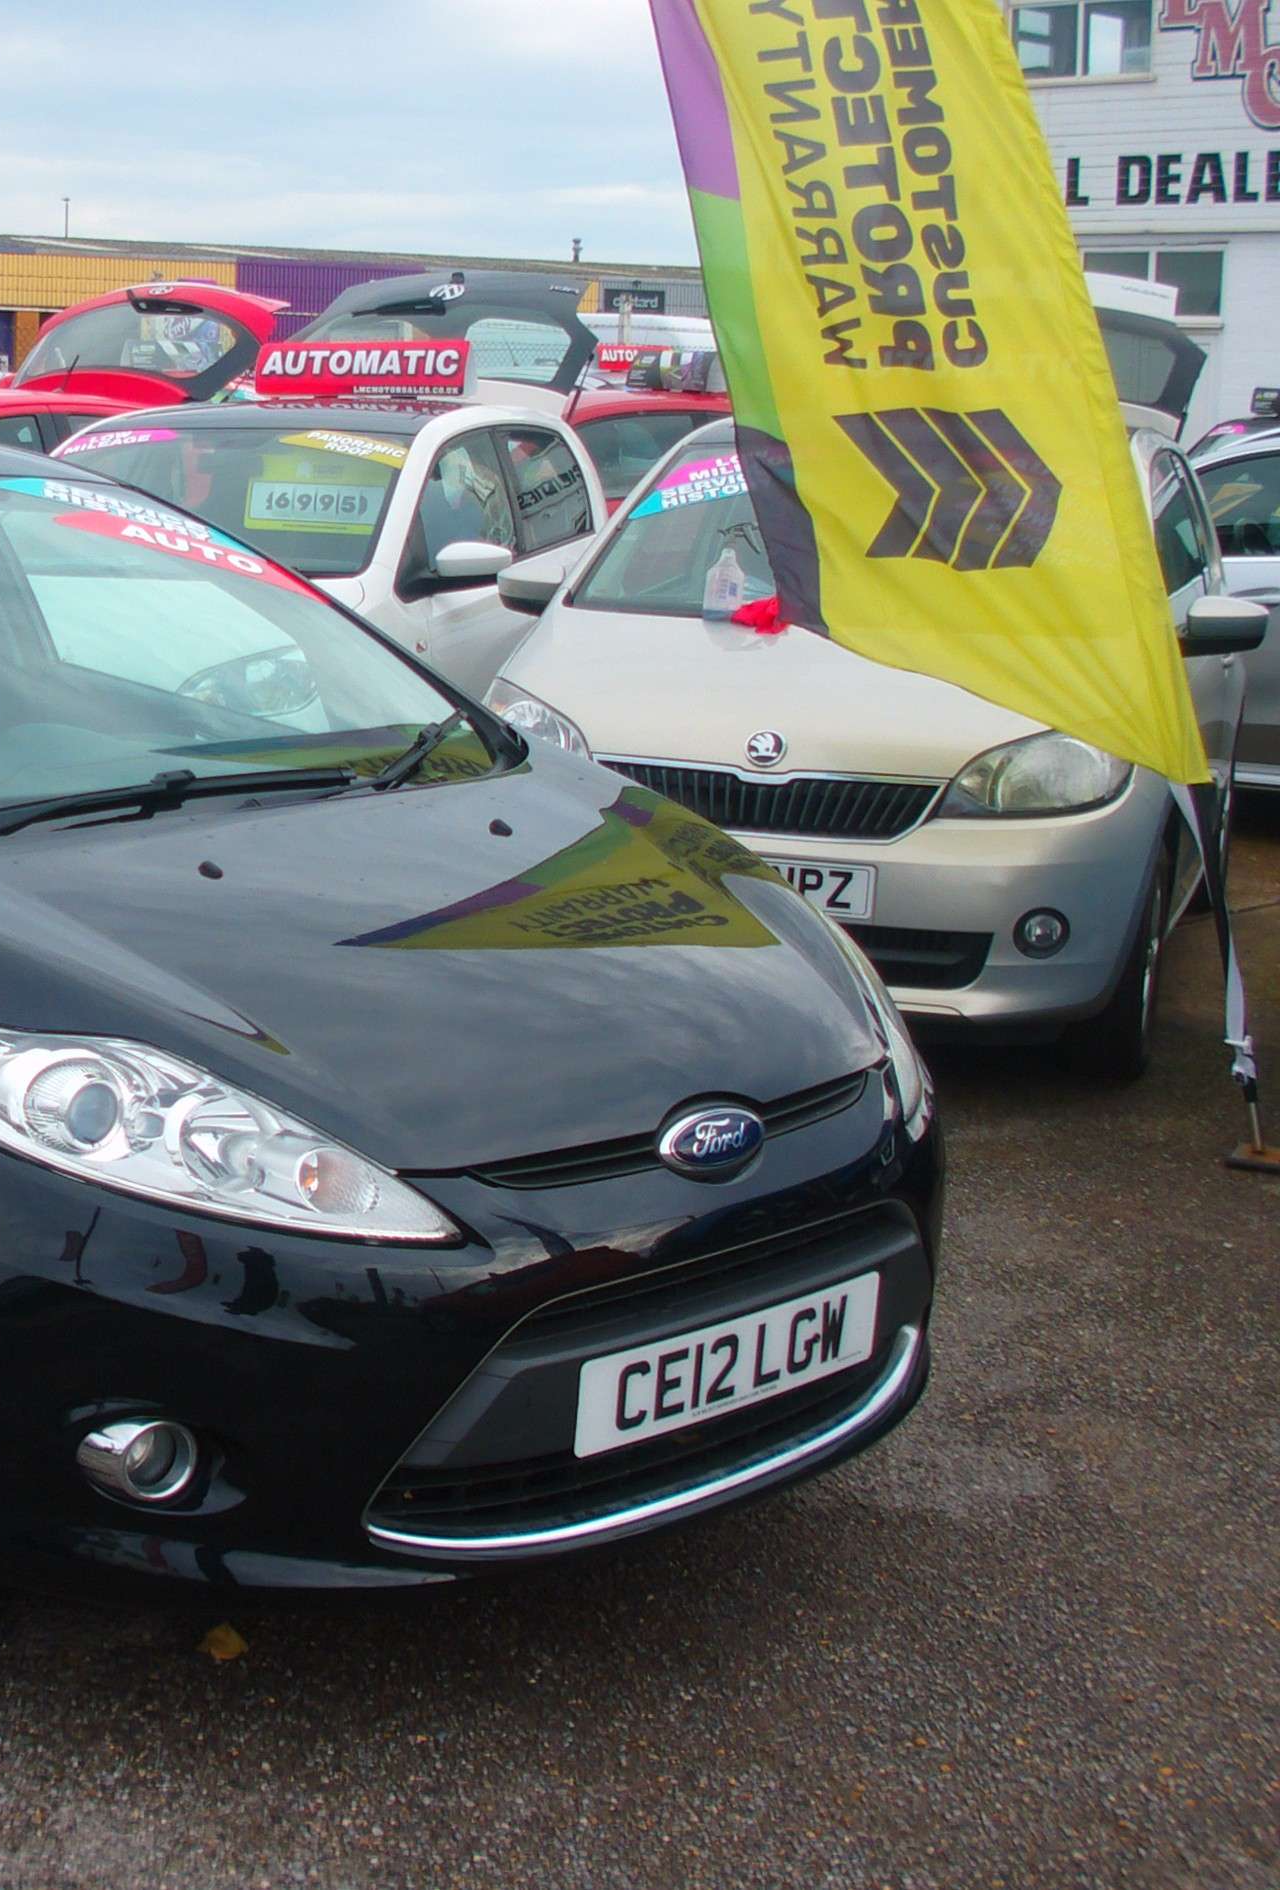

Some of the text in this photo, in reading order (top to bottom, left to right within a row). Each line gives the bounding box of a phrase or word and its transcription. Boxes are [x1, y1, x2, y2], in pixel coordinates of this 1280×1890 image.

[261, 350, 459, 375] AUTOMATIC
[601, 349, 637, 362] AUTO
[307, 430, 405, 457] PANORAMIC
[324, 442, 372, 457] ROOF
[120, 525, 263, 574] AUTO
[693, 1118, 744, 1158] Ford
[615, 1294, 848, 1431] CE12 LGW
